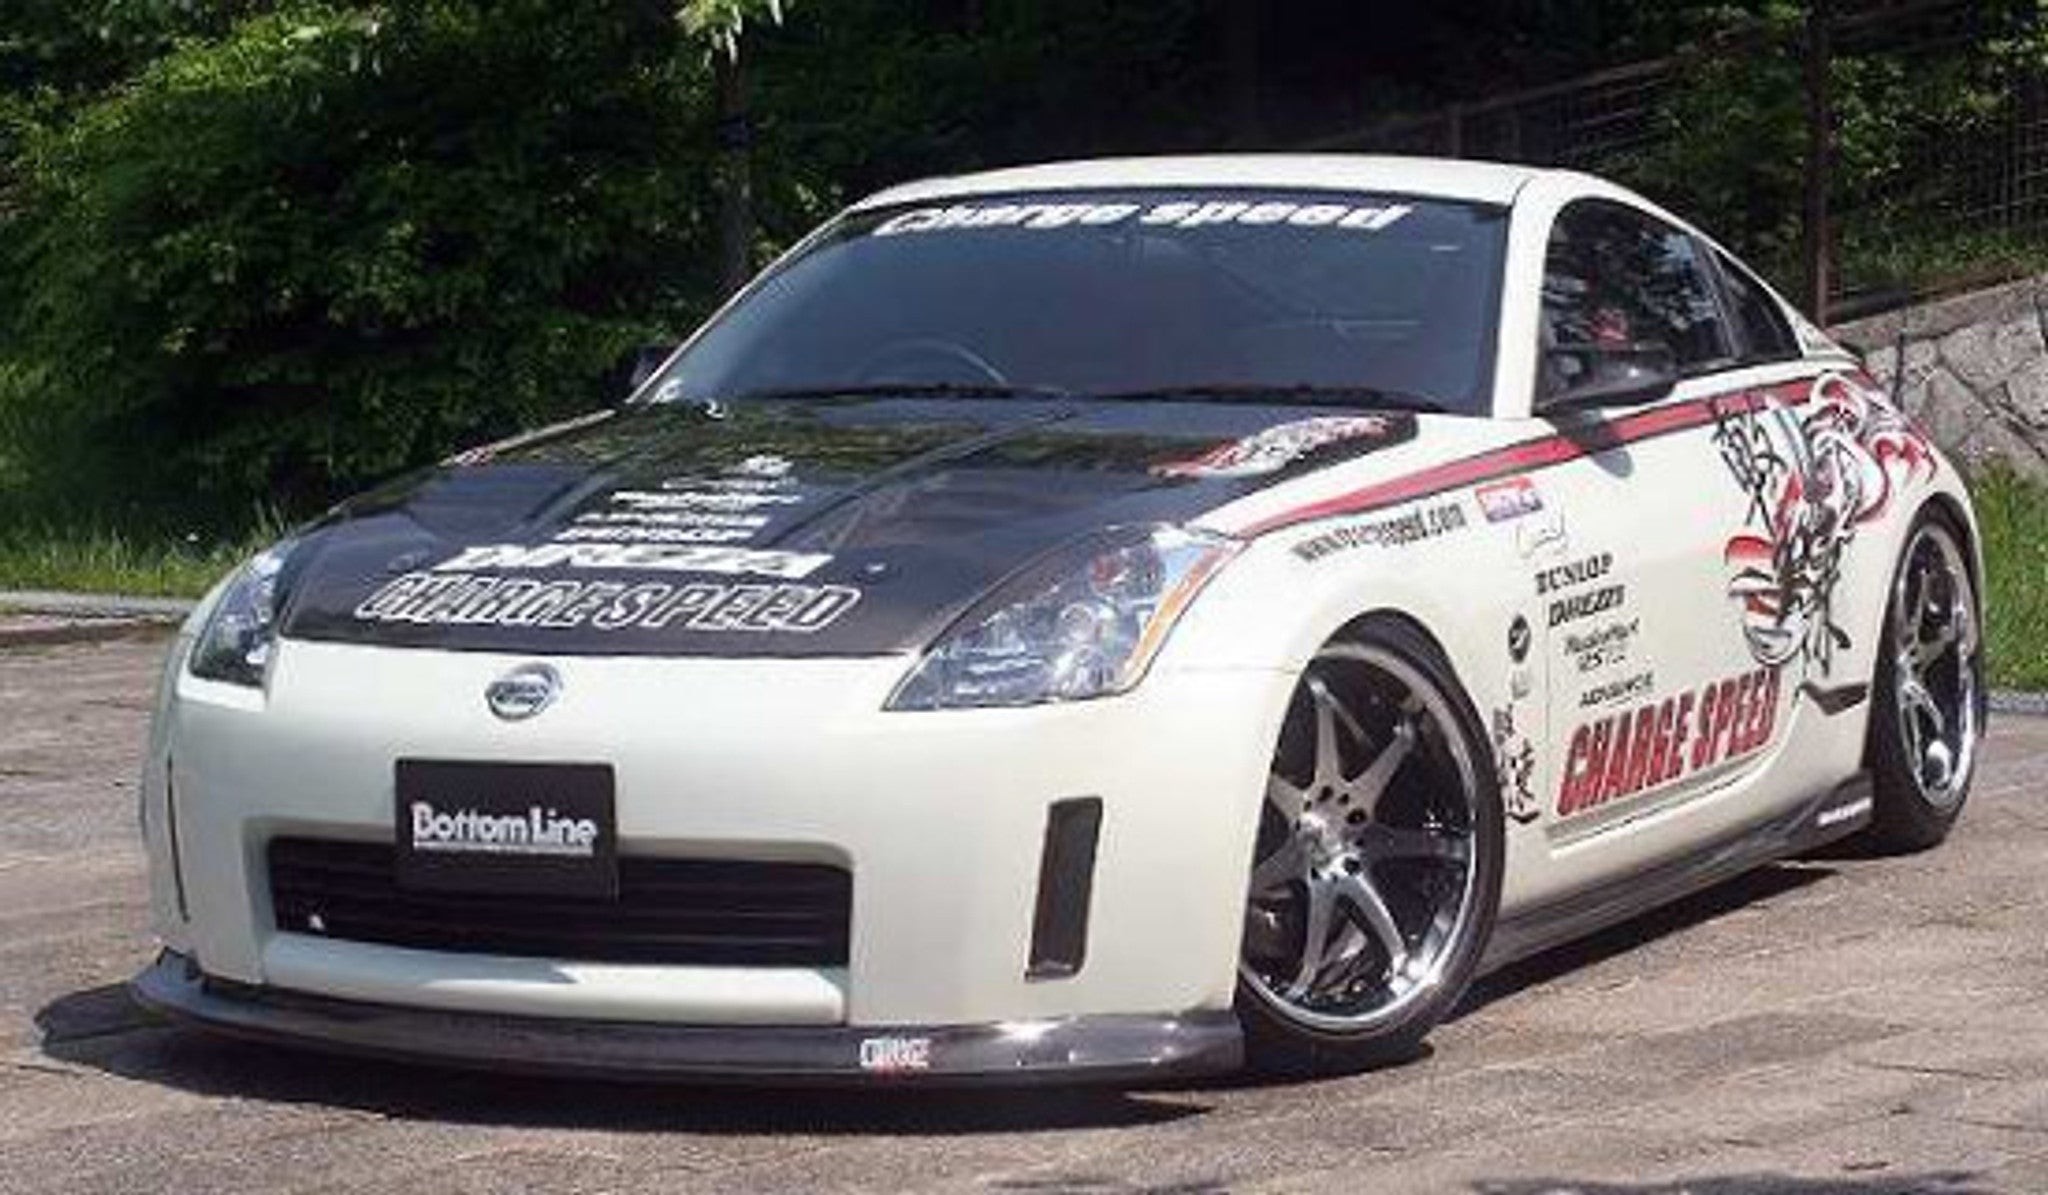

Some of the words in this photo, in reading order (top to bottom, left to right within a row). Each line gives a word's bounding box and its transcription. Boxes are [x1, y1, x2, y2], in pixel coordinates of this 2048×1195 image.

[1140, 200, 1412, 230] speed
[592, 580, 862, 632] SPEED
[1556, 690, 1695, 816] CHARGE
[1690, 661, 1781, 770] SPEED
[411, 802, 527, 841] Bottom
[531, 806, 597, 846] Line
